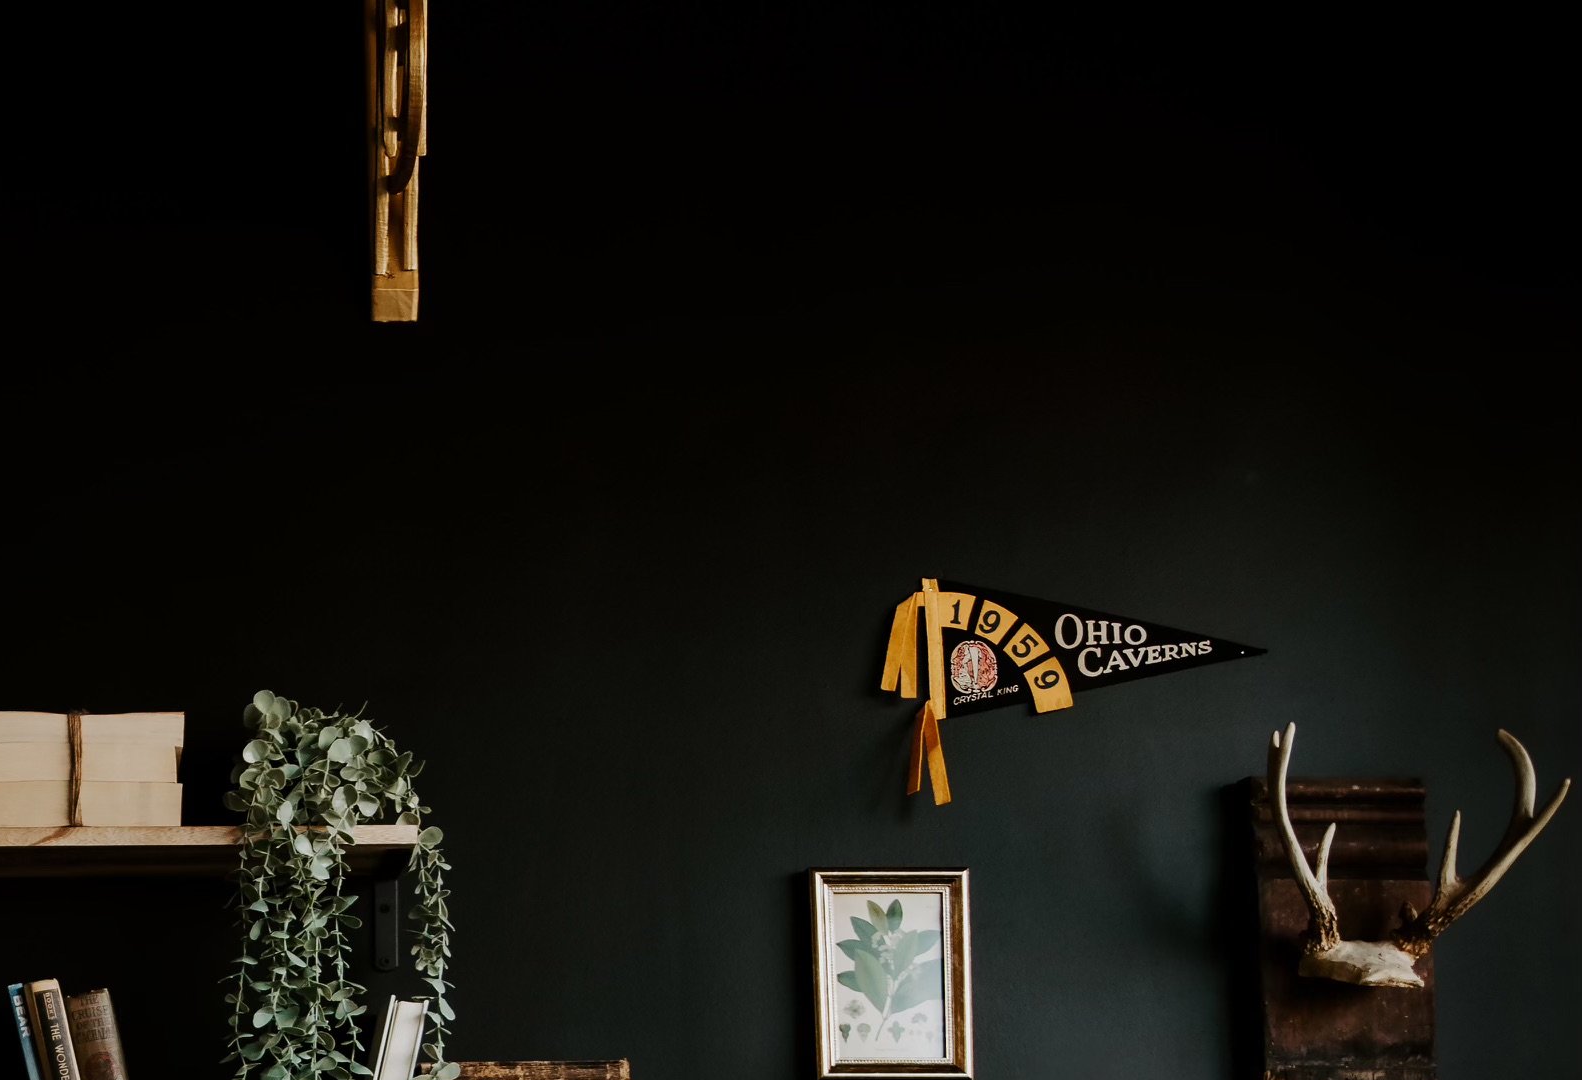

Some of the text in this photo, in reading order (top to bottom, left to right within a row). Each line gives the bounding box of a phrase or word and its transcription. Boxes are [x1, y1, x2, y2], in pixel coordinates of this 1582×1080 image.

[1054, 613, 1147, 649] OHIO
[1077, 639, 1213, 677] CAVERNS
[952, 685, 1020, 706] CRYSTAL KING
[12, 994, 32, 1038] BEAR
[72, 1005, 112, 1021] CRUISE
[50, 1022, 62, 1041] THE
